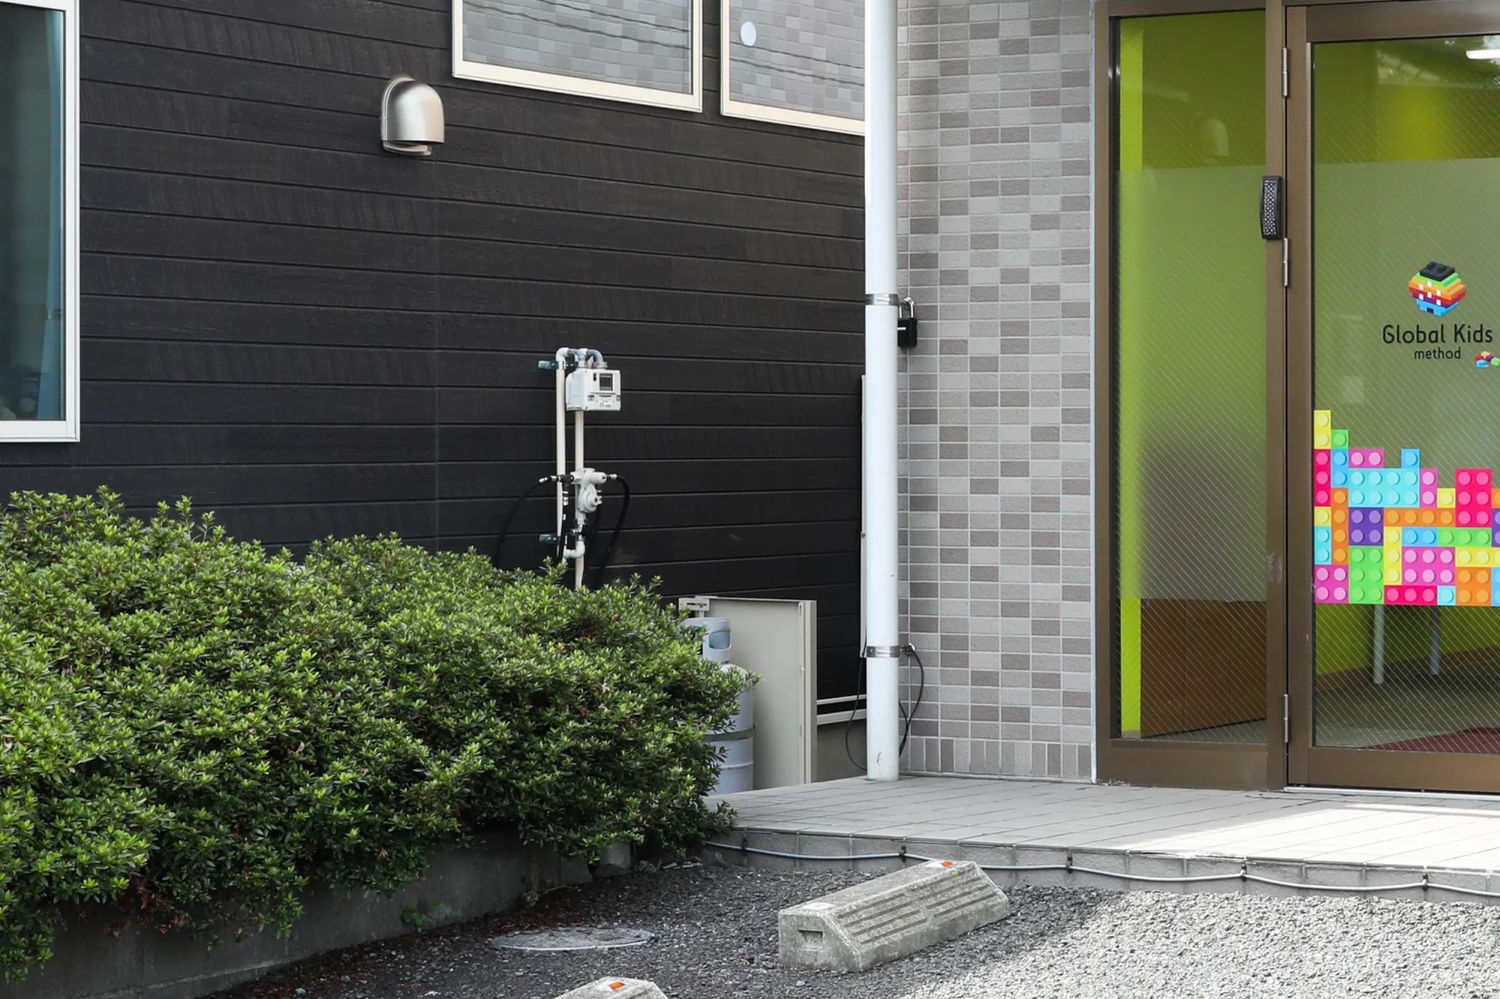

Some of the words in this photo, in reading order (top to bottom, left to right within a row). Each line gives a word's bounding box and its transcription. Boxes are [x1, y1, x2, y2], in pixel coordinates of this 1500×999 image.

[1382, 324, 1446, 344] Global
[1453, 323, 1493, 343] Kids
[1413, 347, 1462, 360] method
